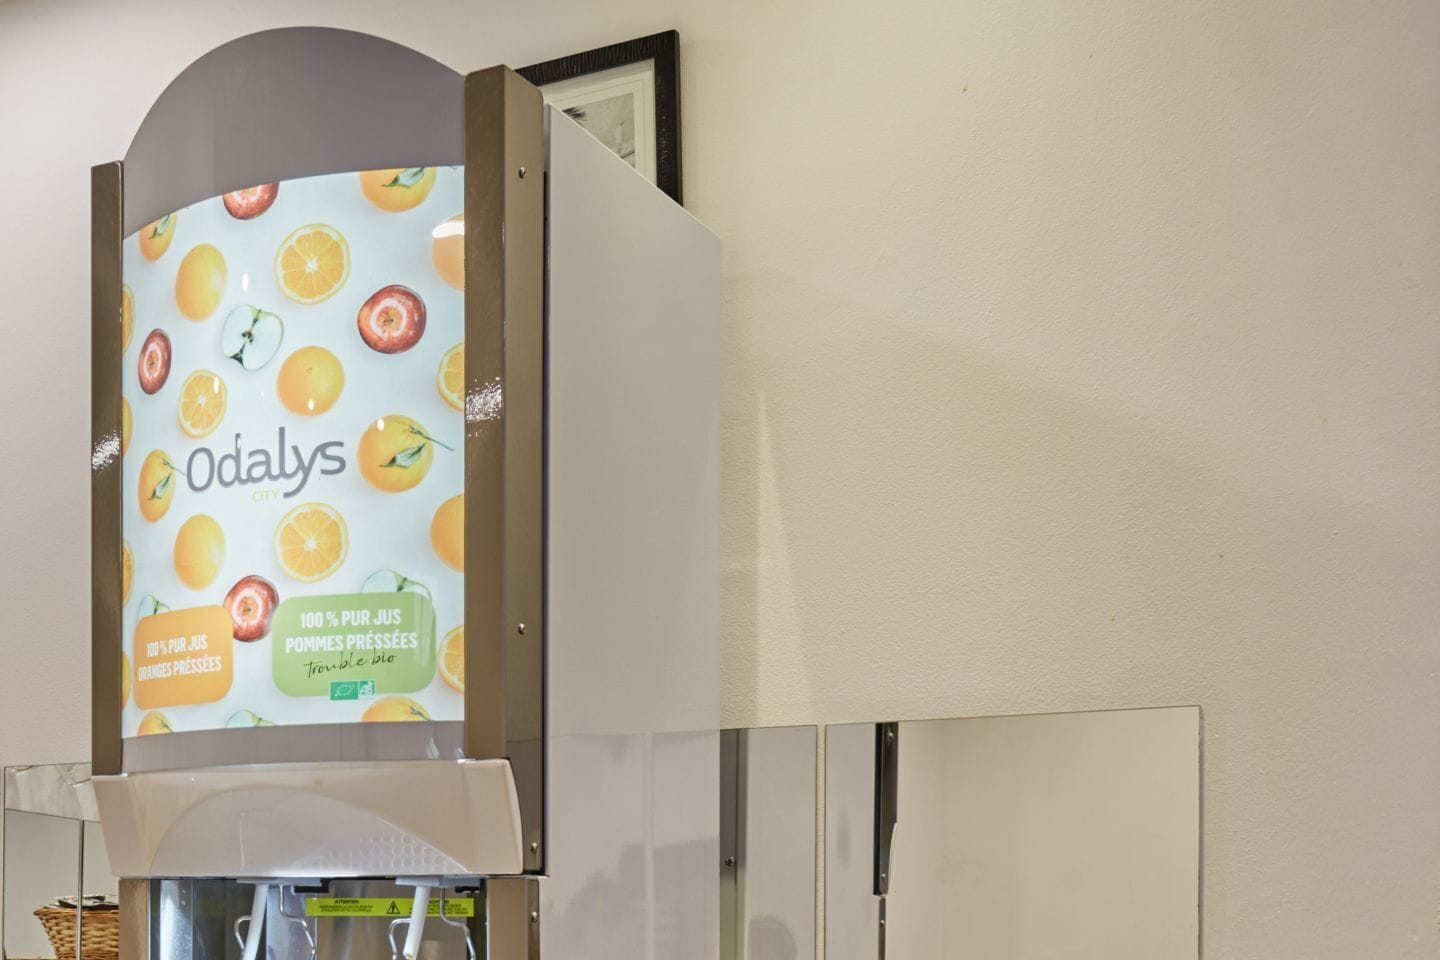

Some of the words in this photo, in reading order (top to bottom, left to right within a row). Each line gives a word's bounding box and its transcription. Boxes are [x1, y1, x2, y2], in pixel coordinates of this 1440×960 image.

[186, 426, 346, 498] Odalys
[252, 490, 280, 502] CITY
[300, 611, 323, 629] 100
[326, 611, 339, 627] %
[341, 610, 371, 627] PUR
[373, 608, 401, 625] JUS
[146, 641, 159, 657] 100
[168, 637, 186, 654] PUR
[188, 634, 208, 651] JUS
[285, 634, 344, 654] POMMES
[346, 629, 418, 651] PRÉSSÉES
[371, 646, 398, 665] bio
[138, 661, 173, 682] ORANGES
[173, 654, 223, 675] PRÉSSÉES
